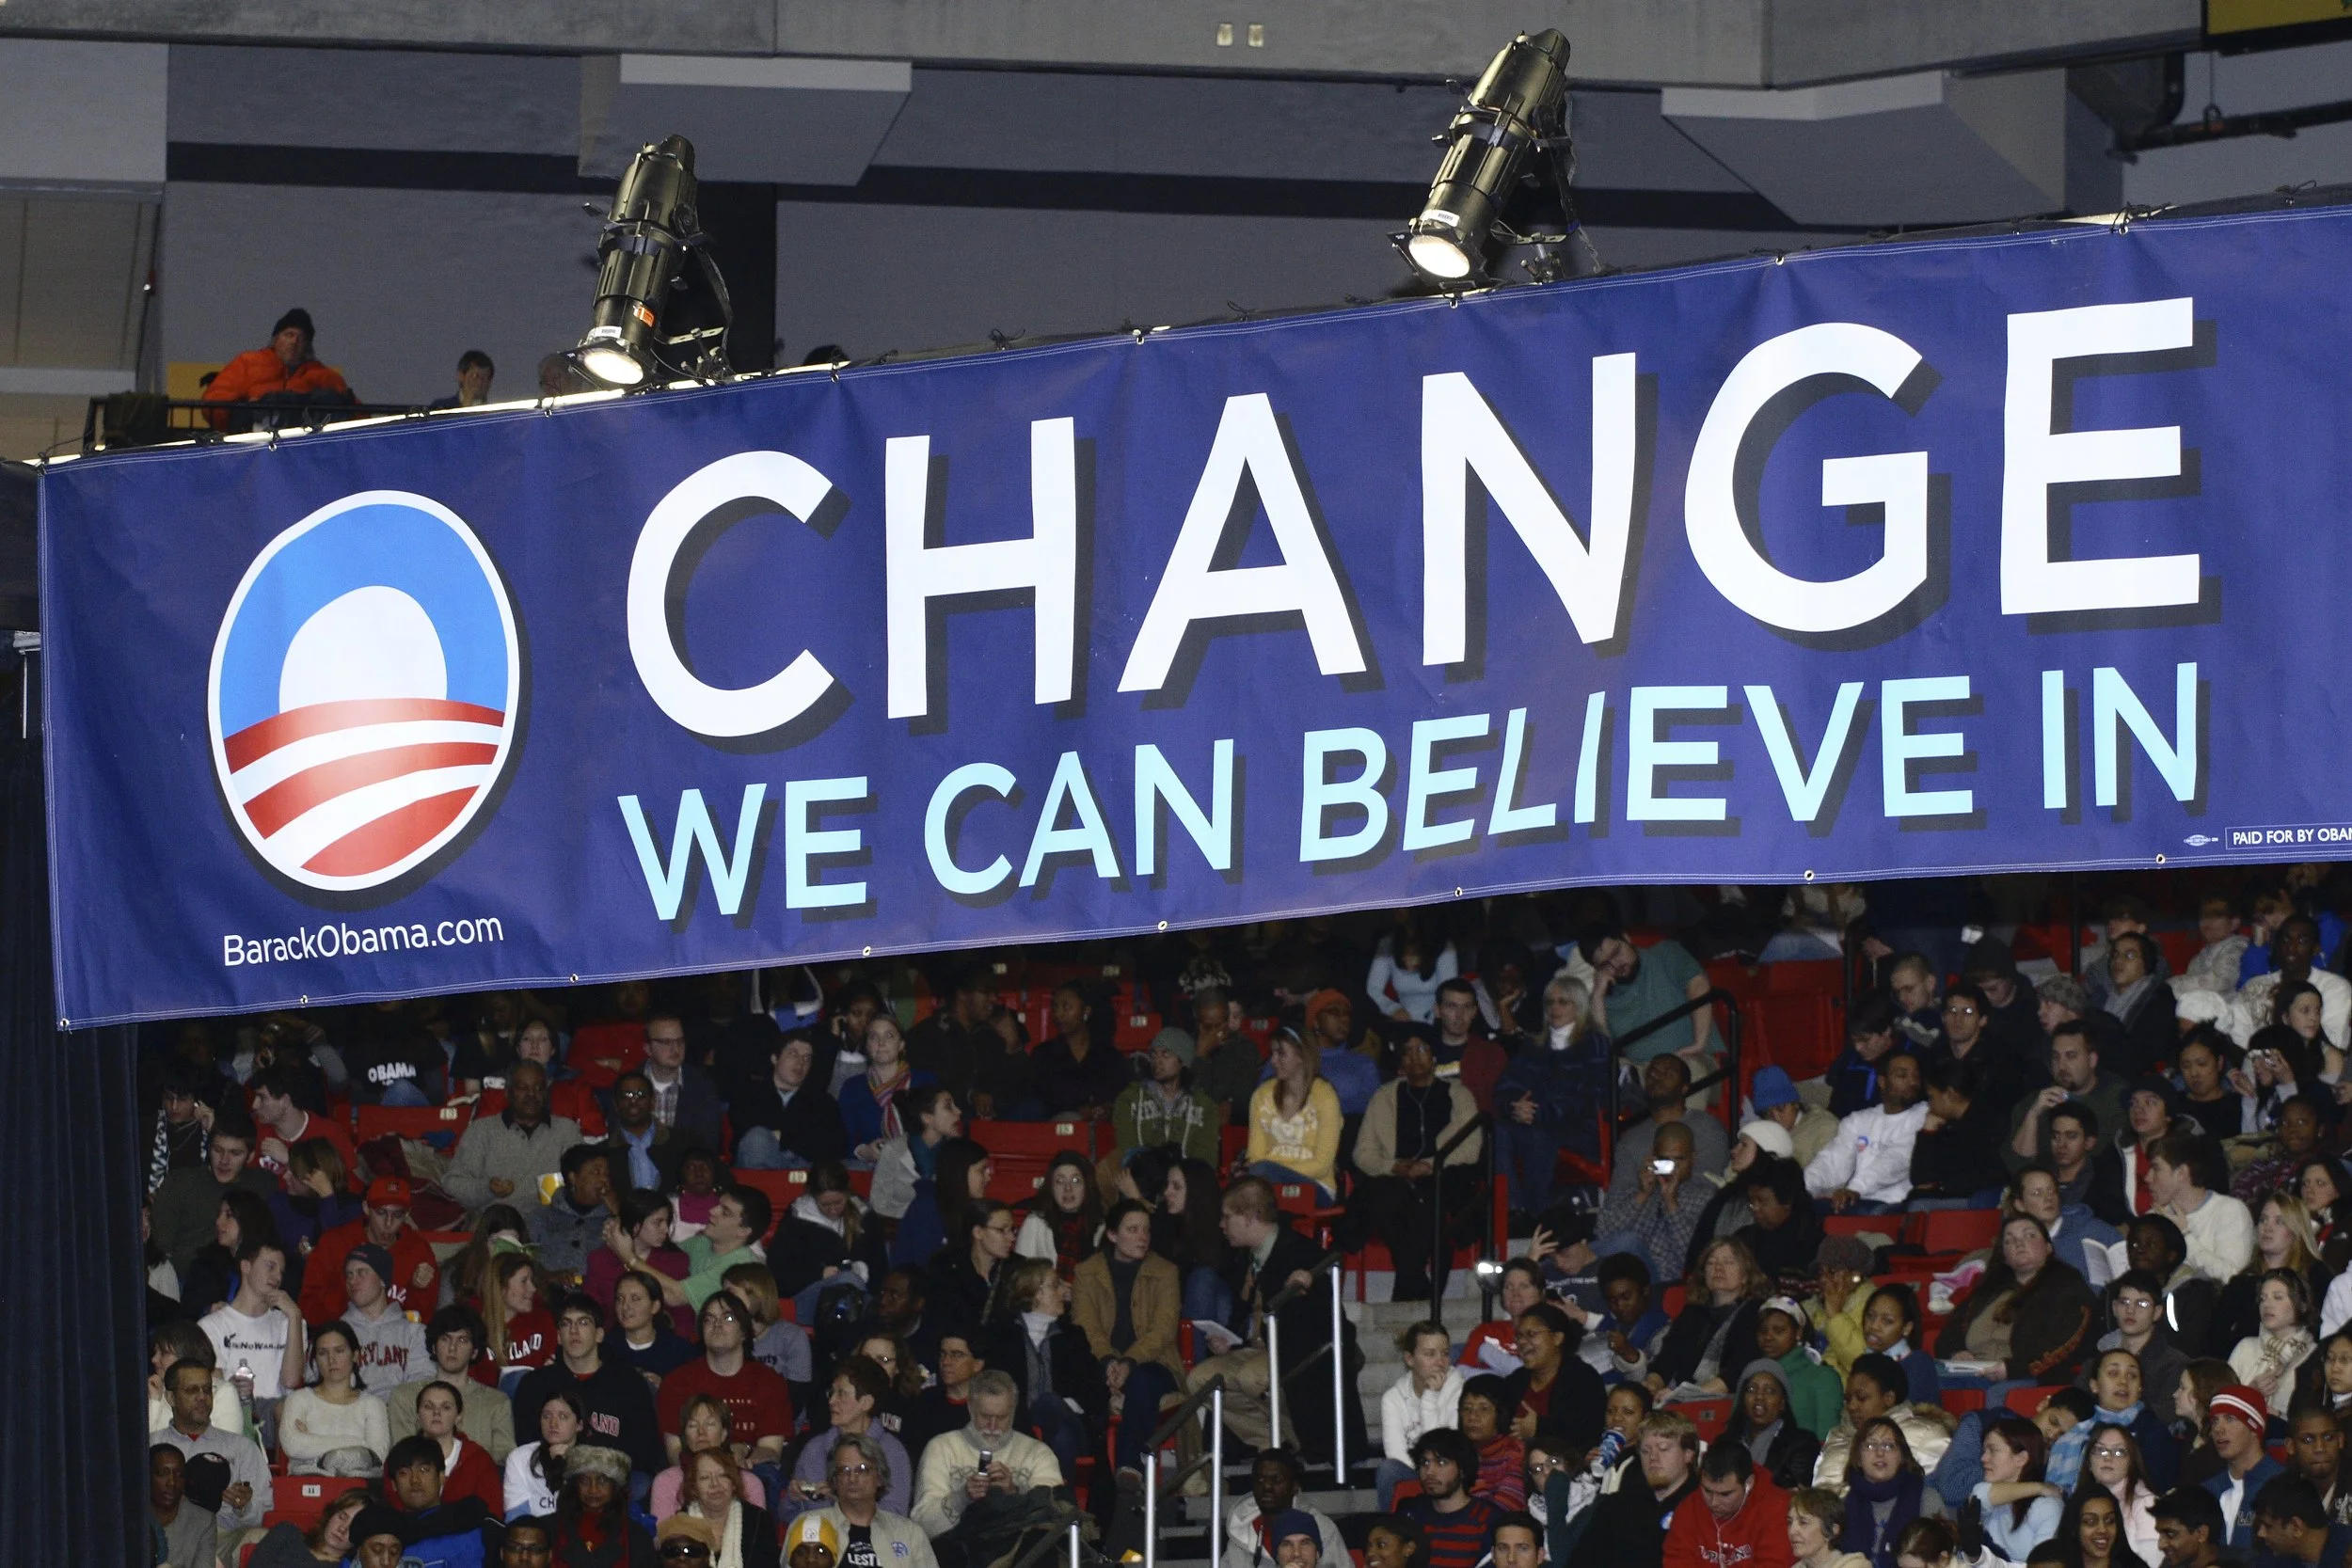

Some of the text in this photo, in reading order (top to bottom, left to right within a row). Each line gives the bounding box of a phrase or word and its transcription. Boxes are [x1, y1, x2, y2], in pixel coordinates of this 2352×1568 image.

[627, 296, 2201, 737] CHANGE
[617, 662, 2199, 921] WE CAN BELIEVE IN
[2233, 830, 2263, 846] PAID
[2265, 829, 2294, 845] FOR
[2296, 828, 2315, 843] BY
[222, 916, 505, 967] BarackObama.com
[368, 1061, 417, 1084] OBAMA
